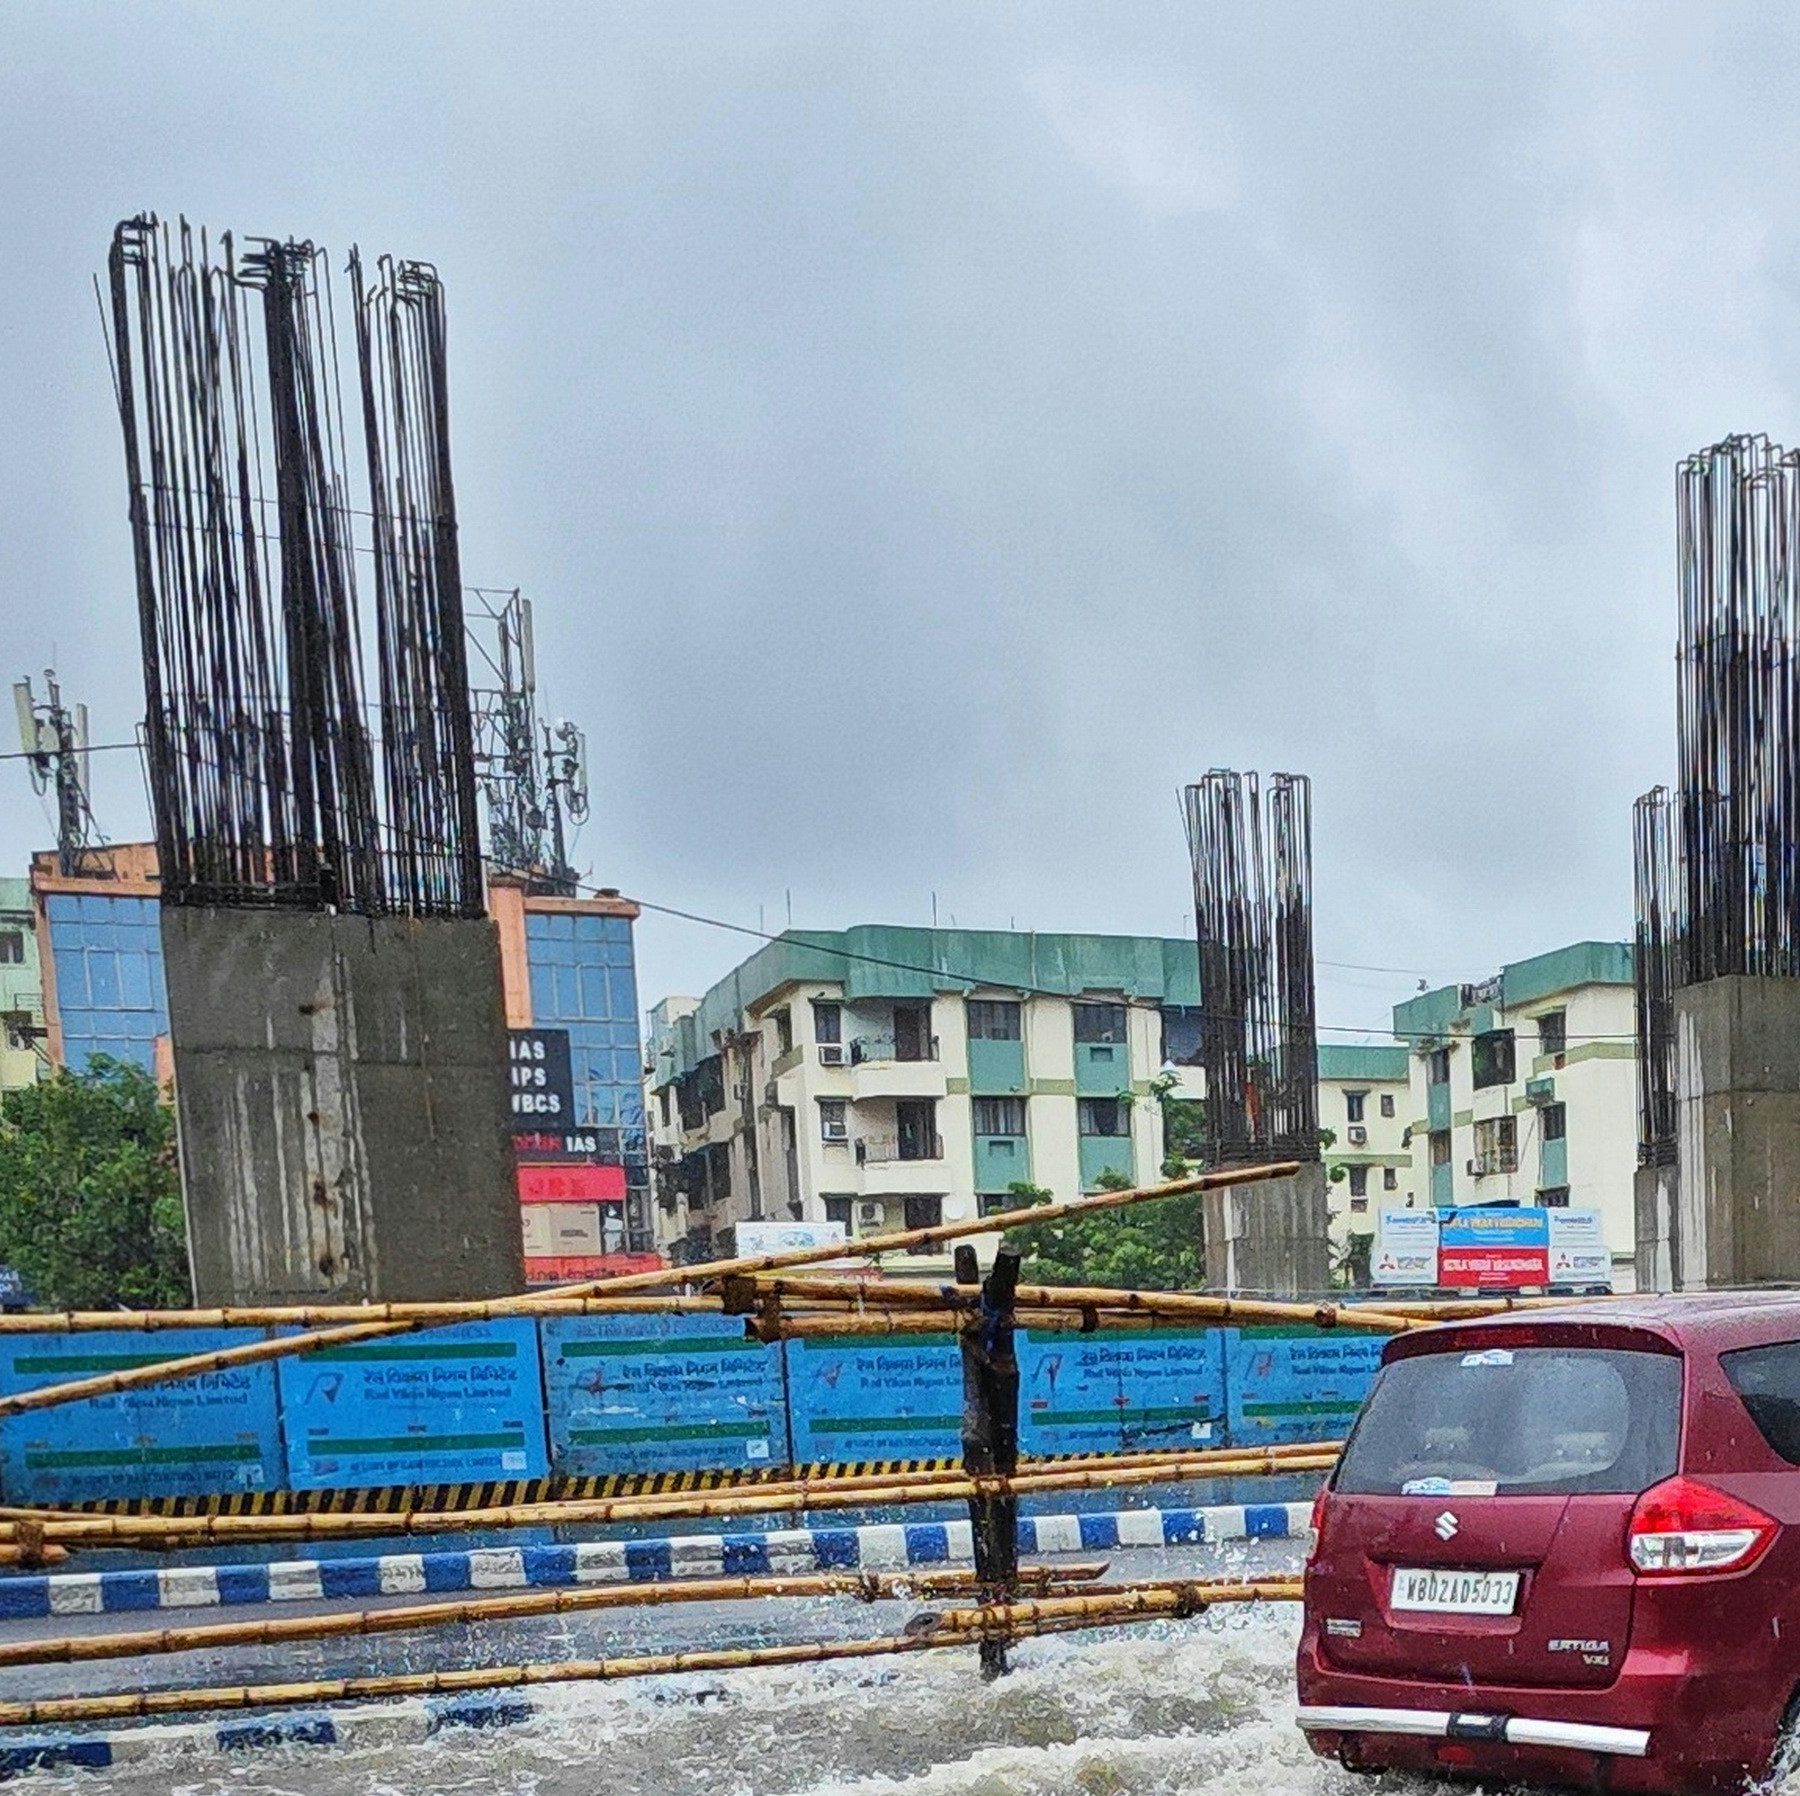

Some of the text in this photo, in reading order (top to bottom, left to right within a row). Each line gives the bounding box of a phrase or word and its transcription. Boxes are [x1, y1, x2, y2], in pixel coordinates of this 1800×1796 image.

[509, 1040, 546, 1060] IAS
[512, 1066, 547, 1086] IPS
[565, 1135, 597, 1153] IAS
[1548, 1639, 1610, 1652] ERTIGA
